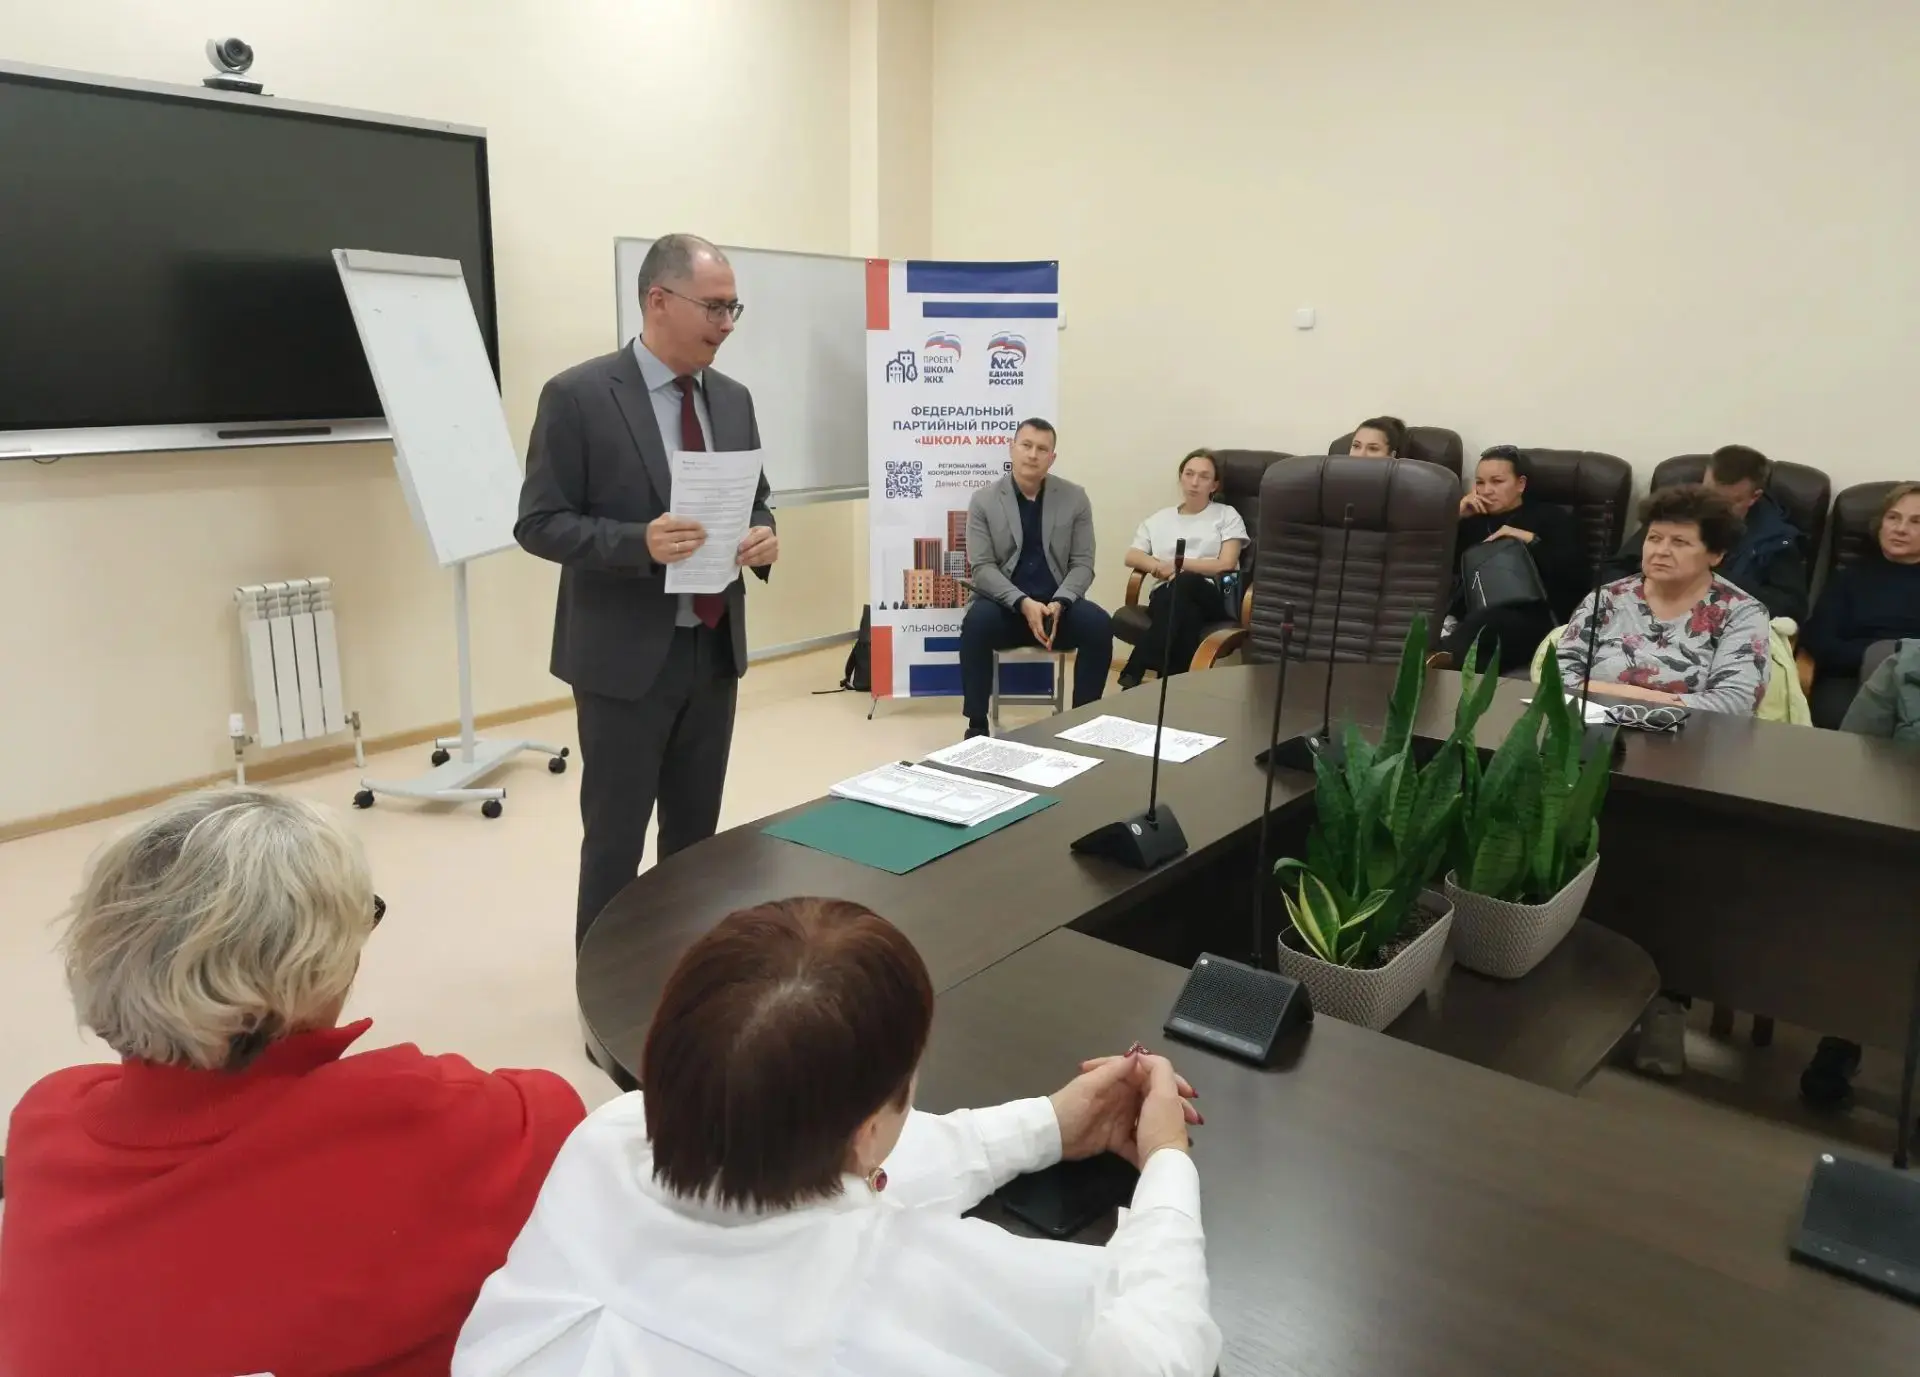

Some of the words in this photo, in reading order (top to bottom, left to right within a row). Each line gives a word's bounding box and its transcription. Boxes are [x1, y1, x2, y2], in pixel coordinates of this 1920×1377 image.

[923, 355, 953, 364] ПРОЕКТ
[923, 366, 954, 374] ШКОЛА
[923, 375, 944, 384] ЖКХ
[911, 404, 1014, 417] ФЕДЕРАЛЬНЫЙ
[893, 419, 977, 431] ПАРТИЙНЫЙ
[981, 421, 1019, 431] ПРОЕ
[914, 435, 971, 445] «ШКОЛА
[901, 623, 962, 633] УЛЬЯНОВСК
